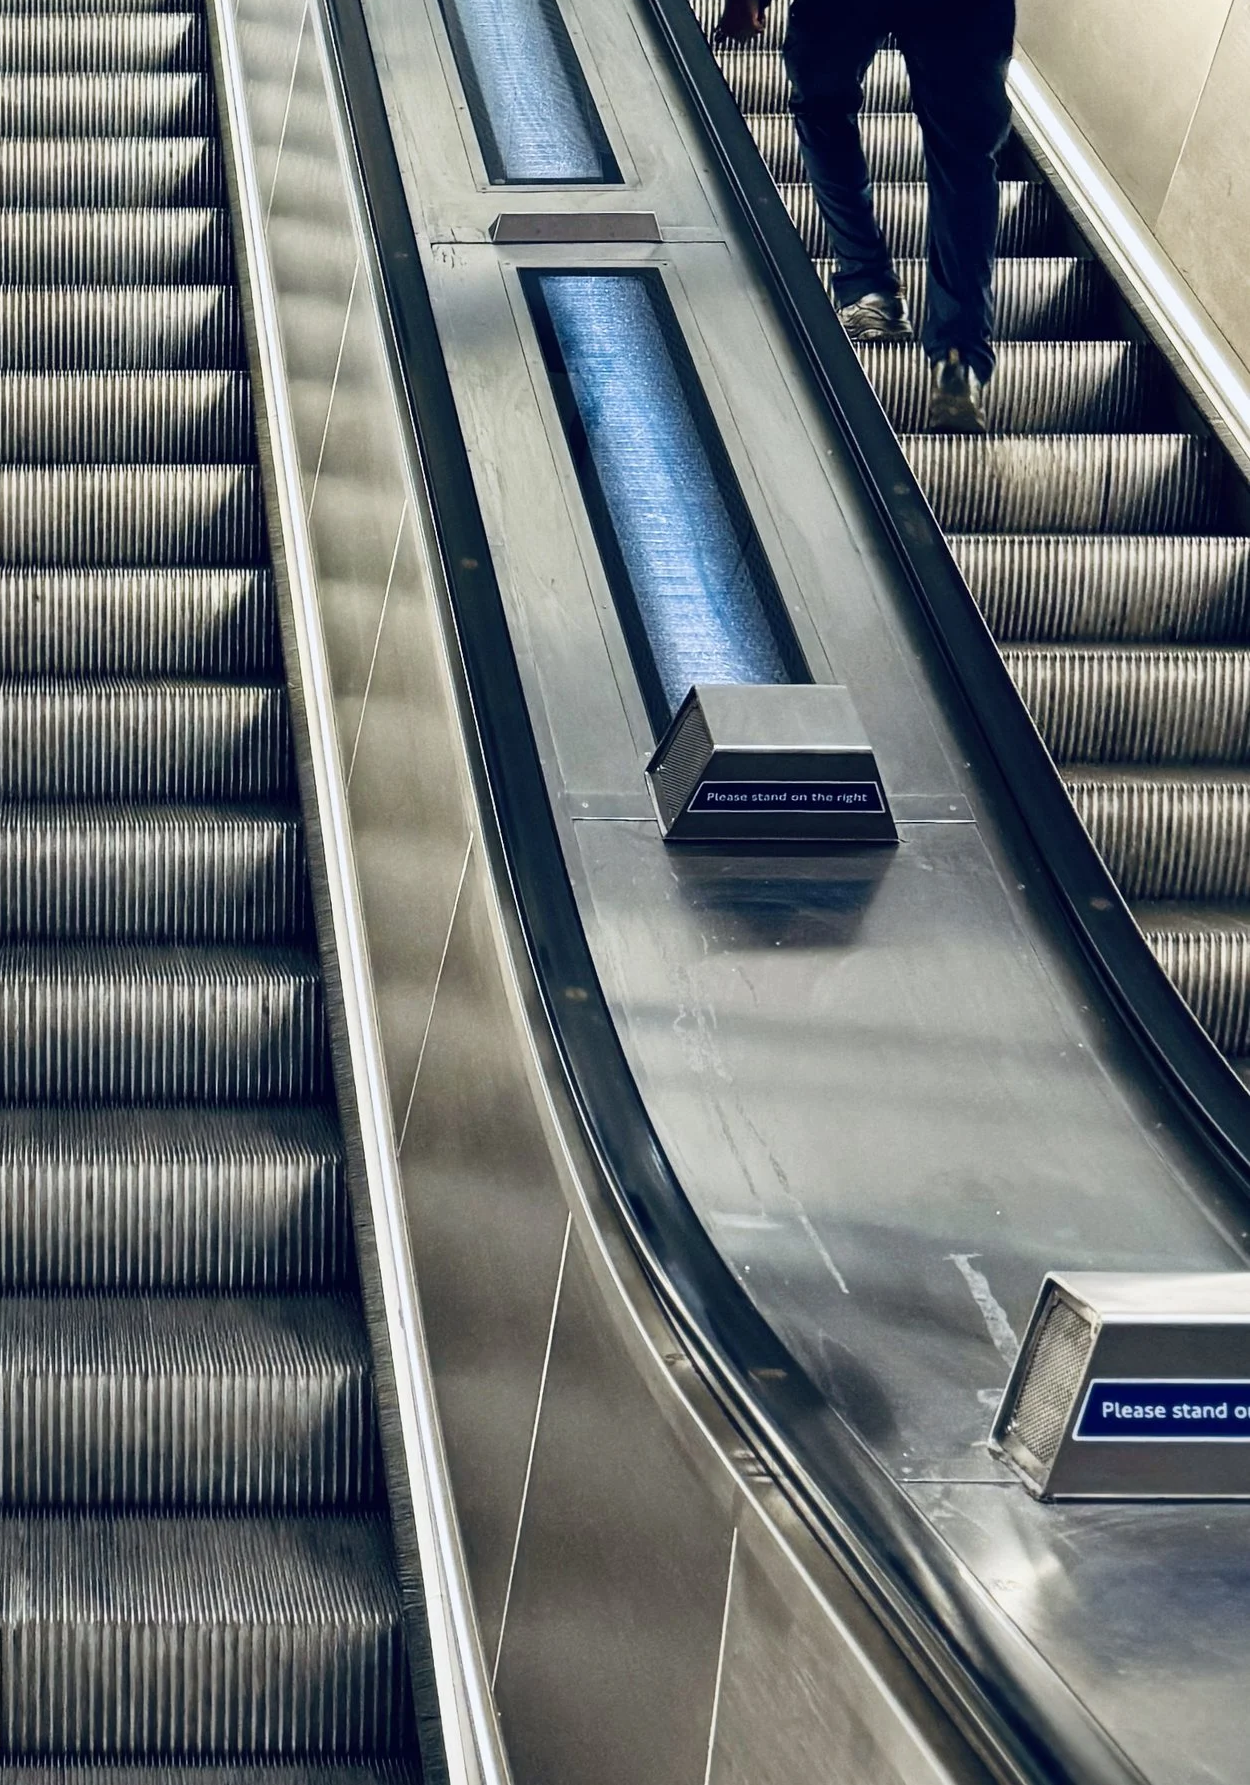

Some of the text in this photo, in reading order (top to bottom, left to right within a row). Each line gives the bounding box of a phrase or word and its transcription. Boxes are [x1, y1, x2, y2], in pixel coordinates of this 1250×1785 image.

[706, 792, 868, 804] Please stand on the right
[1102, 1401, 1250, 1420] Please stand o
